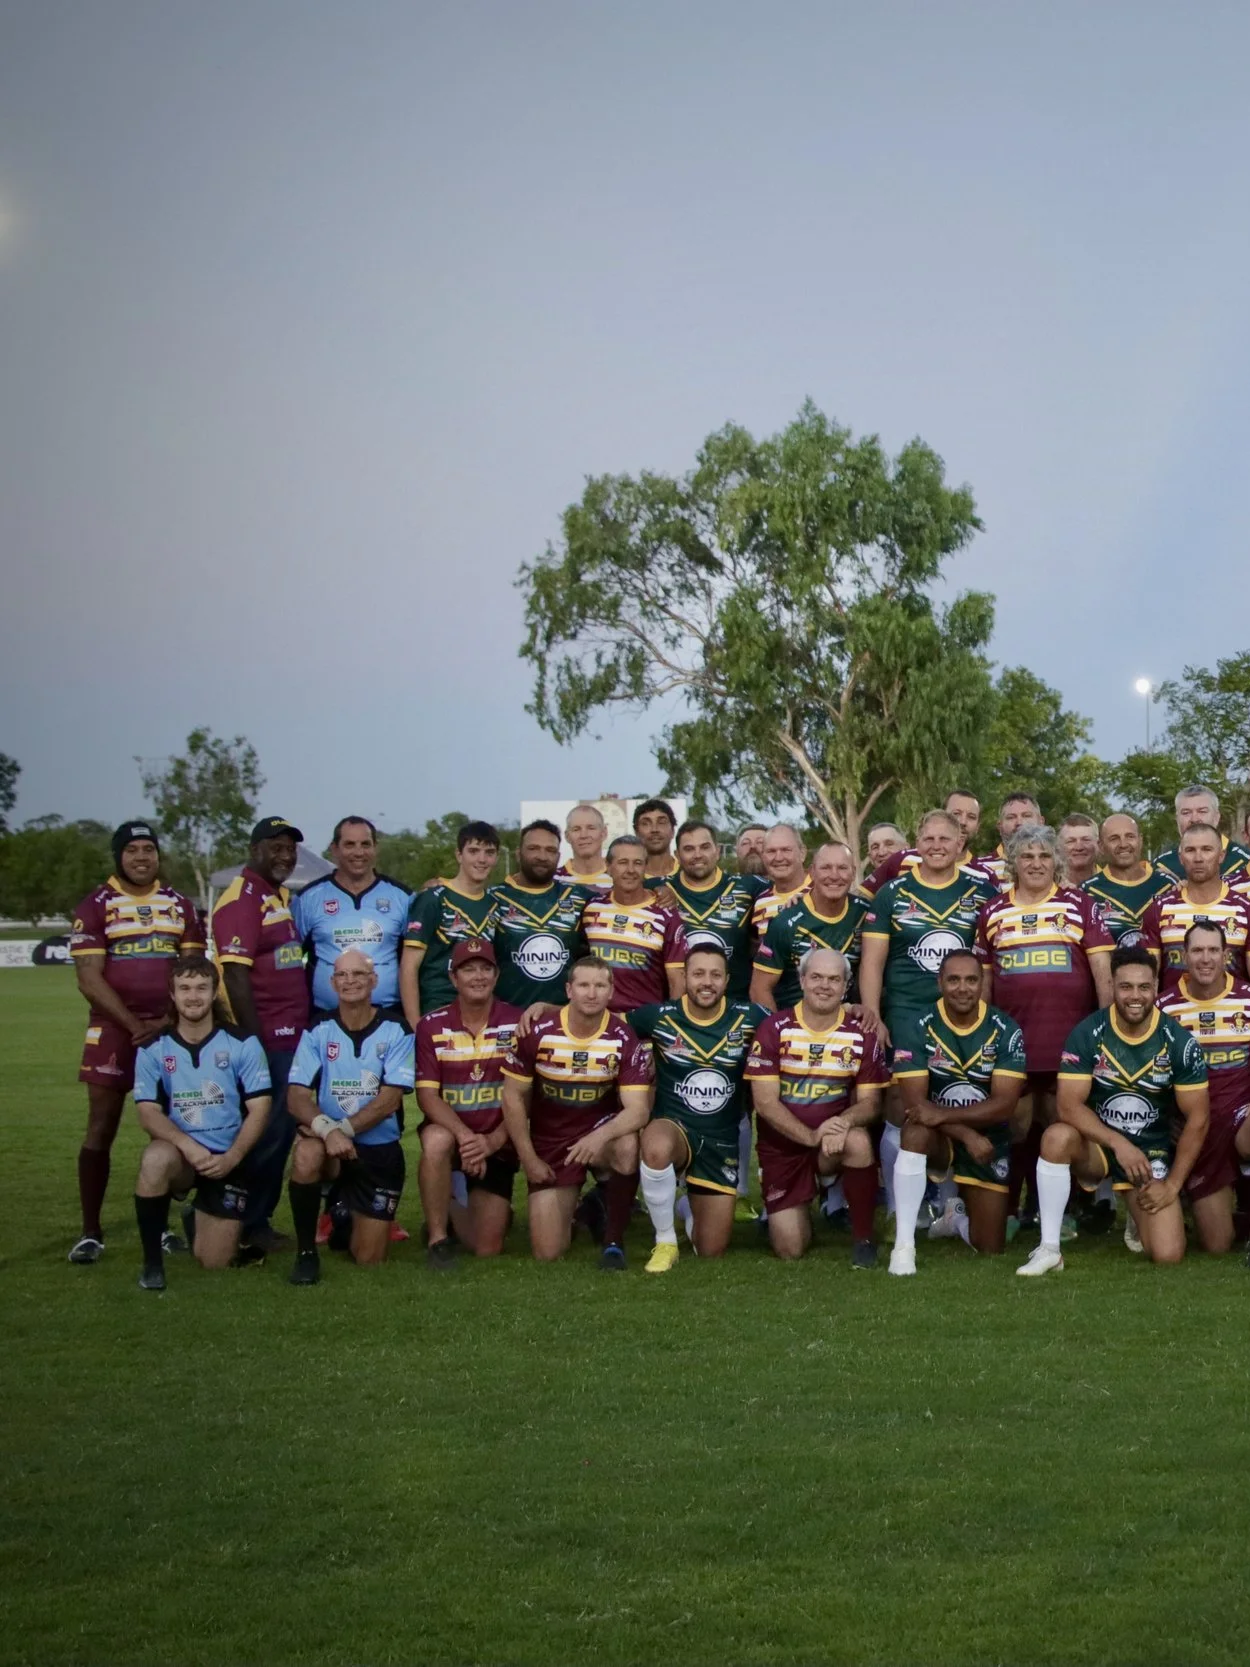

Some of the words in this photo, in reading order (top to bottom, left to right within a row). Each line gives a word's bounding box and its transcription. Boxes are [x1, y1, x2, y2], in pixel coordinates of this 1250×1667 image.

[512, 951, 569, 962] MINING
[909, 948, 952, 957] MINI
[1001, 950, 1067, 969] QUBE
[173, 1090, 203, 1099] MENDI
[675, 1082, 735, 1097] MINING
[173, 1099, 225, 1108] BLACKHAWKS
[1097, 1105, 1158, 1121] MINING
